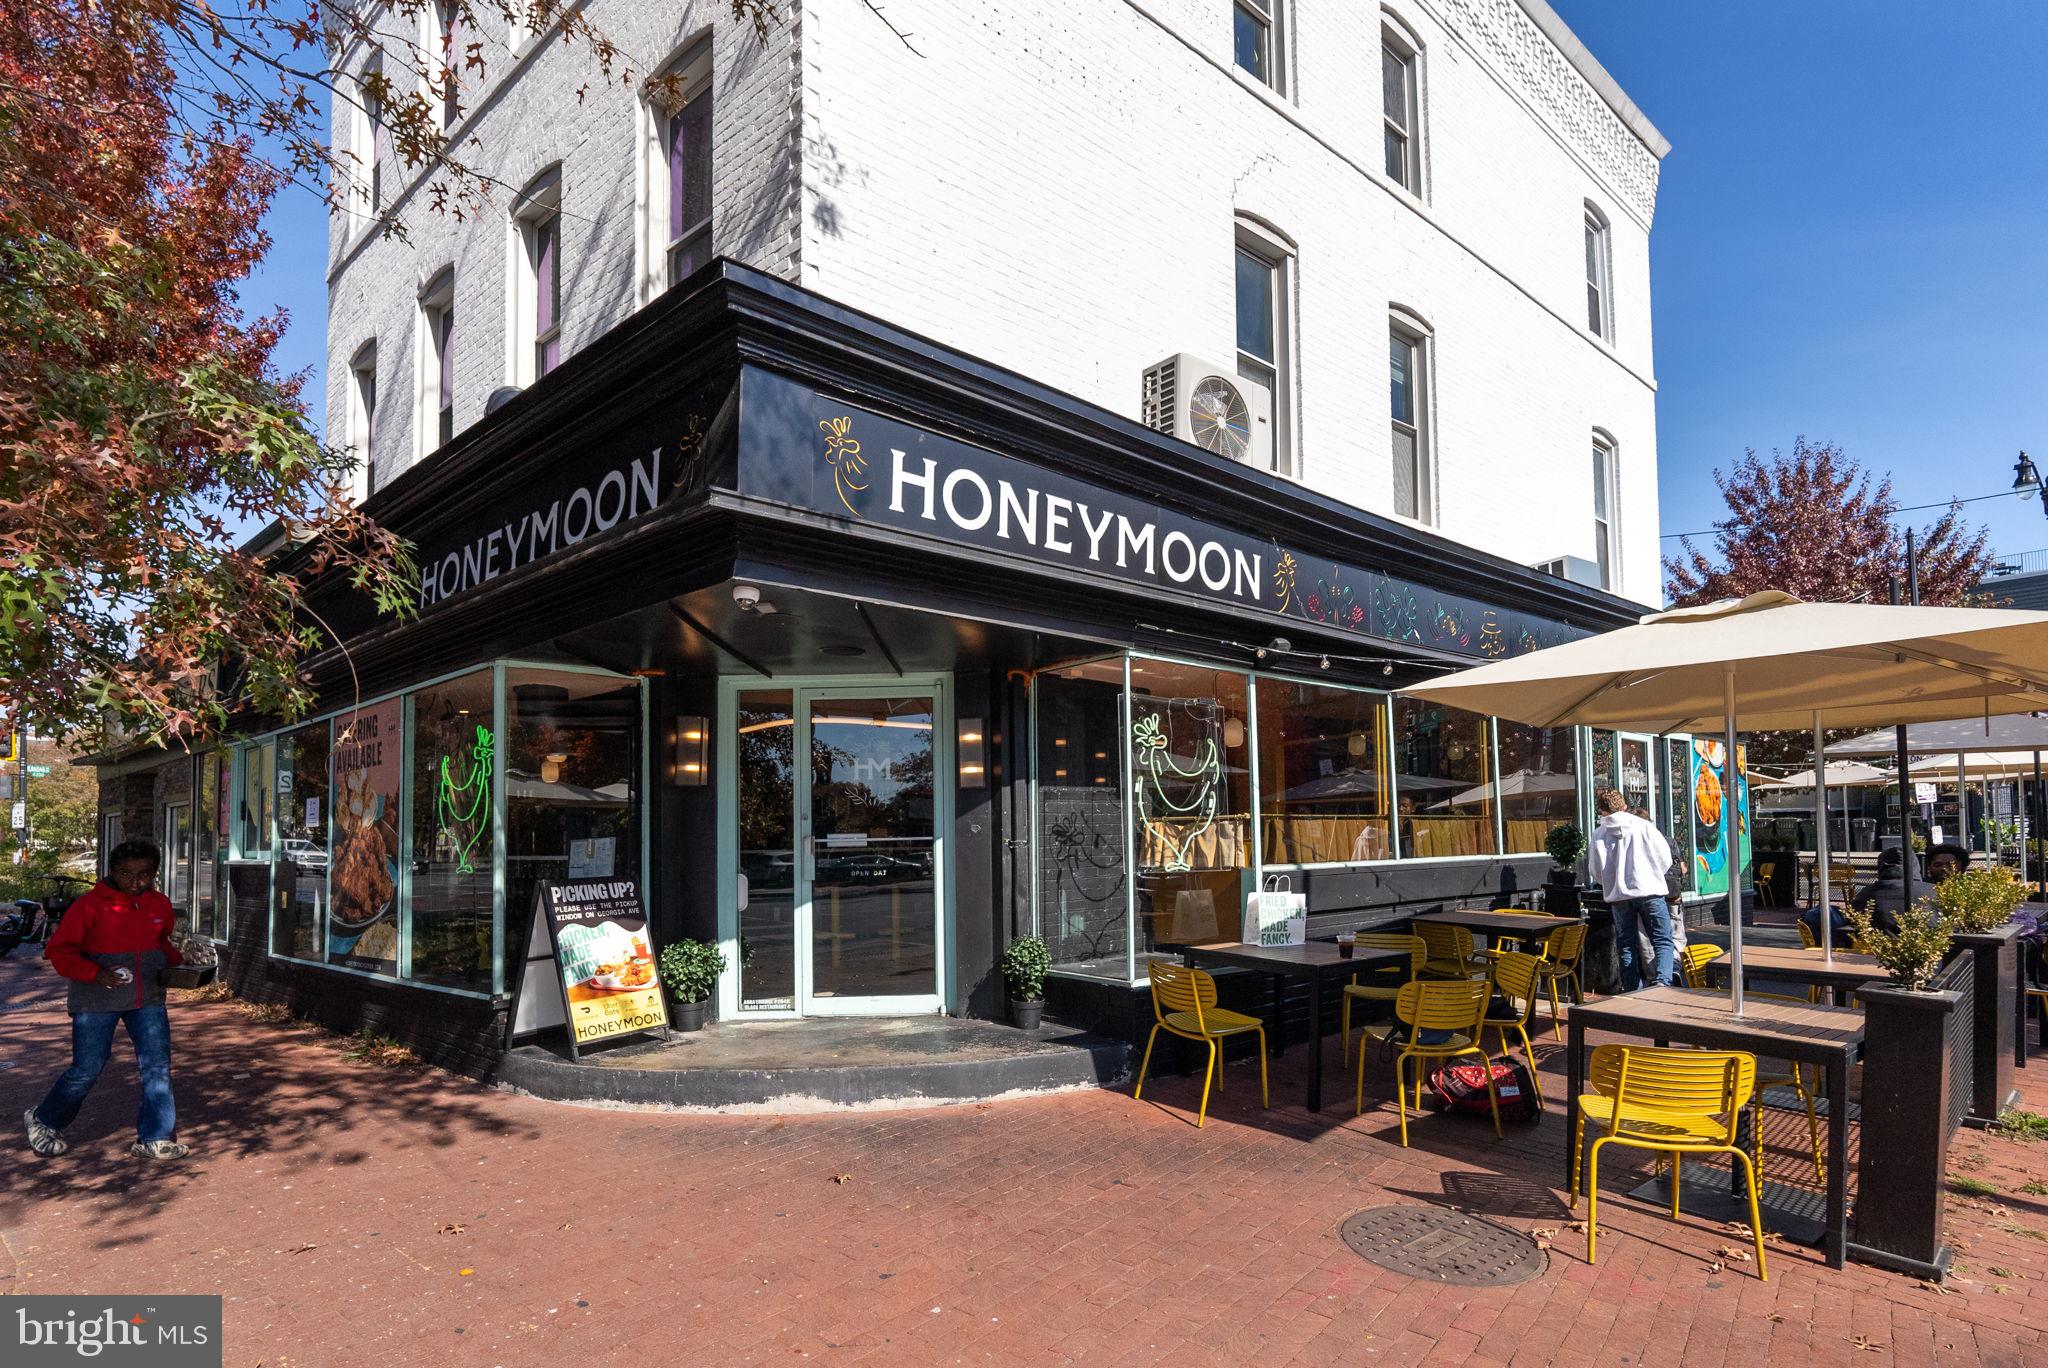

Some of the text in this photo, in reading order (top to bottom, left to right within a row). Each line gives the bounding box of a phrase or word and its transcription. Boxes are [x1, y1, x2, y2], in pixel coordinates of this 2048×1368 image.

[420, 447, 663, 610] HONEYMOON
[888, 448, 1262, 600] HONEYMOON
[336, 741, 382, 775] AVAILABLE
[13, 816, 23, 826] 25
[551, 881, 635, 903] PICKING UP?
[554, 905, 581, 914] PLEASE
[584, 903, 597, 911] USE
[615, 900, 638, 908] PICKUP
[1259, 895, 1287, 907] FRIED
[555, 913, 583, 921] WINDOW
[585, 911, 595, 919] ON
[597, 909, 625, 917] GEORGIA
[1260, 907, 1305, 921] CHICKEN,
[1261, 920, 1288, 933] MADE
[1261, 932, 1293, 945] FANCY.
[560, 943, 593, 967] MADE
[603, 1001, 619, 1009] Uber
[604, 1007, 620, 1016] Eats
[578, 1012, 662, 1039] HONEYMOON
